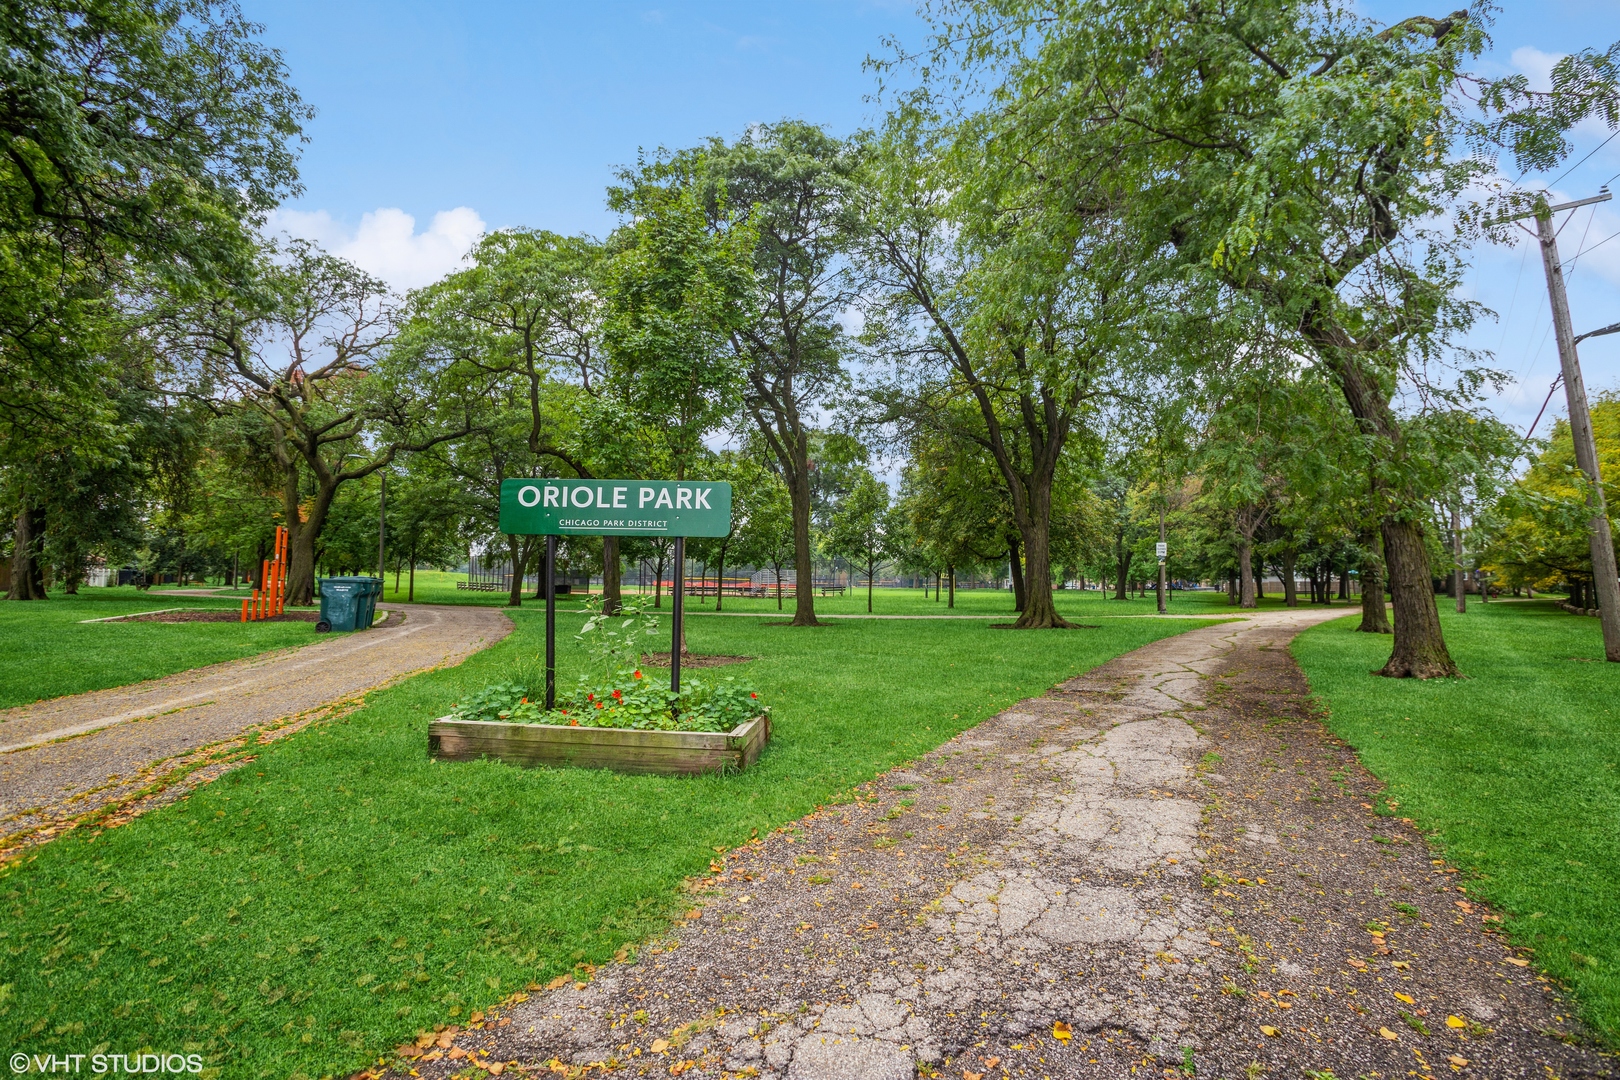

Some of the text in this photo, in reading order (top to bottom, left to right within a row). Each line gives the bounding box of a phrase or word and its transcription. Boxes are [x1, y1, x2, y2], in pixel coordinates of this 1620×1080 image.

[517, 485, 712, 510] ORIOLE PARK
[559, 518, 668, 528] CHICAGO PARK DISTRICT
